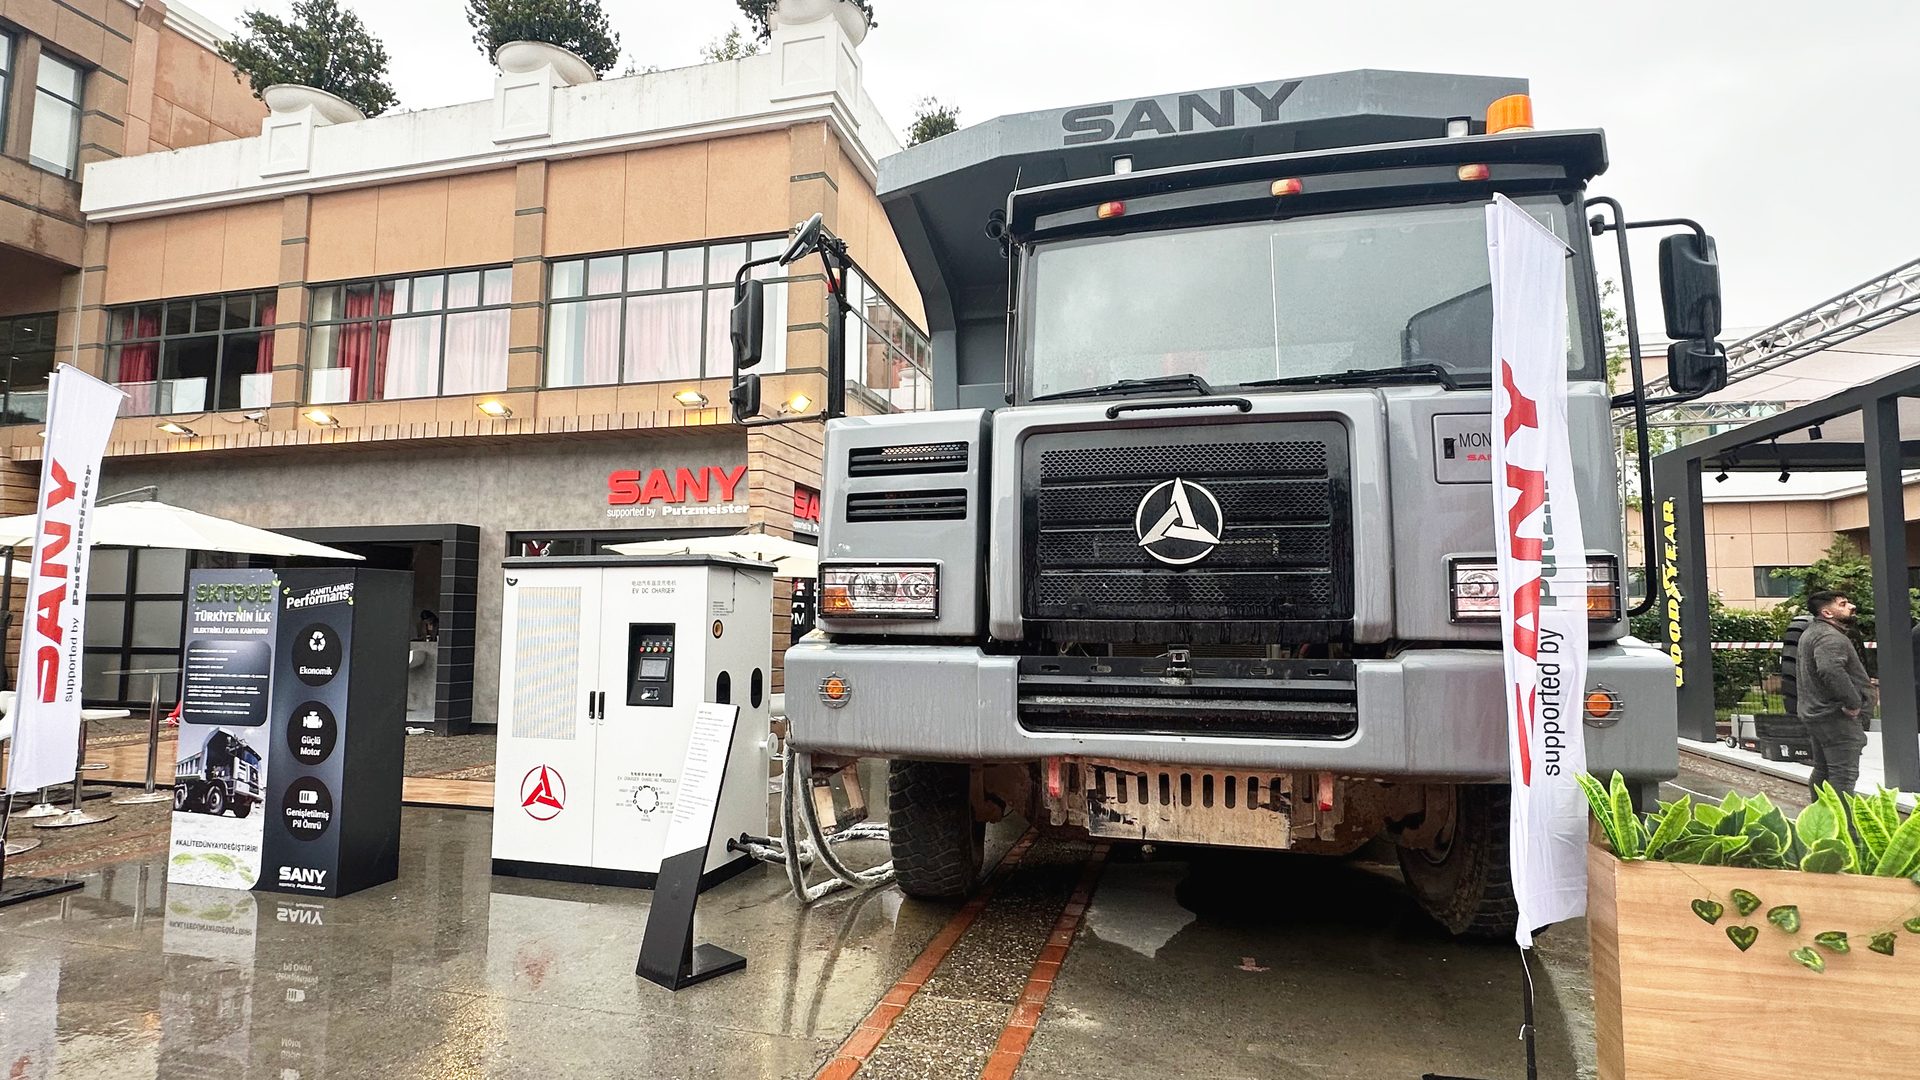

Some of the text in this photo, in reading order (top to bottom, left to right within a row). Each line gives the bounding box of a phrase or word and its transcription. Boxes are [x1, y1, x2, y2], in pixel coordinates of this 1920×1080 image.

[1061, 80, 1303, 146] SANY
[607, 465, 748, 505] SANY
[606, 503, 750, 518] supported by Putzmeister
[64, 464, 91, 702] supported by Putzmeister
[286, 590, 349, 609] Performans
[194, 610, 272, 622] TÜRKİYE'NİN İLK
[1538, 628, 1564, 654] by
[299, 666, 332, 676] Ekonomik
[1537, 663, 1565, 777] supported
[301, 735, 321, 746] Güçlü
[300, 747, 321, 756] Motor
[286, 807, 330, 821] Genişletilmiş
[292, 819, 322, 830] Pil Ömrü
[279, 866, 327, 884] SANY
